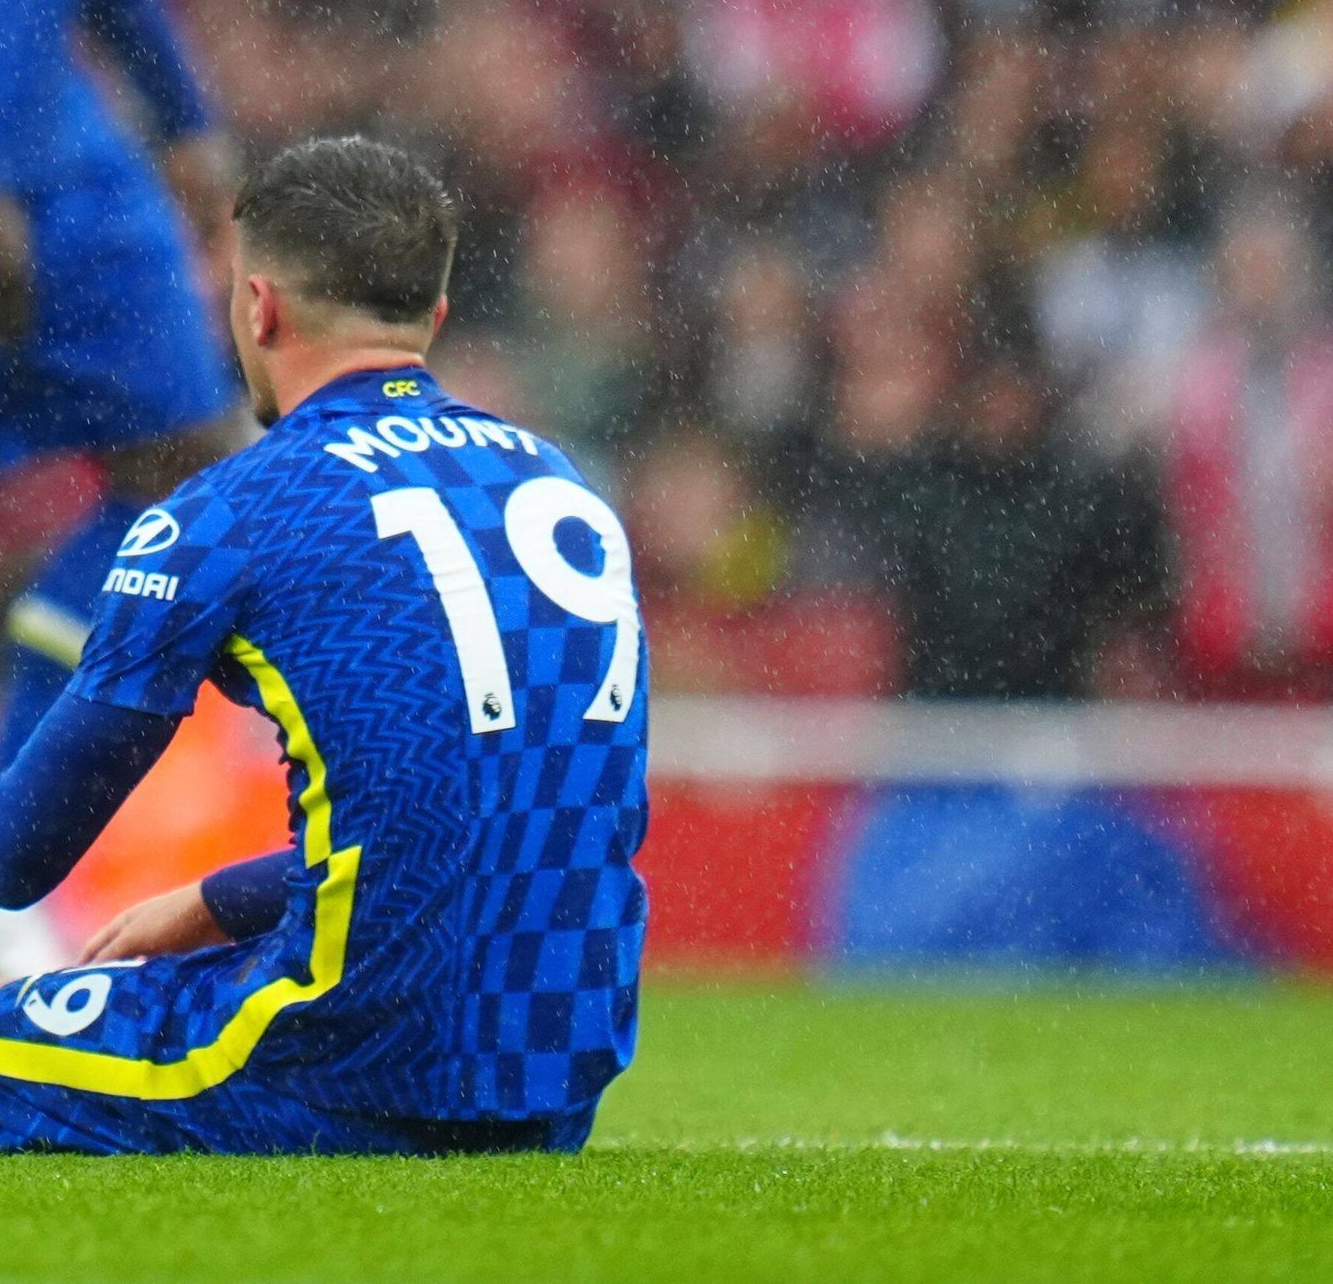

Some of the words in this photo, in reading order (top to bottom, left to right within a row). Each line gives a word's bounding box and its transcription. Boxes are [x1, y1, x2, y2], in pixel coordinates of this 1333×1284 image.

[382, 379, 421, 398] CFC
[323, 415, 539, 474] MOUNT
[369, 475, 642, 735] 19
